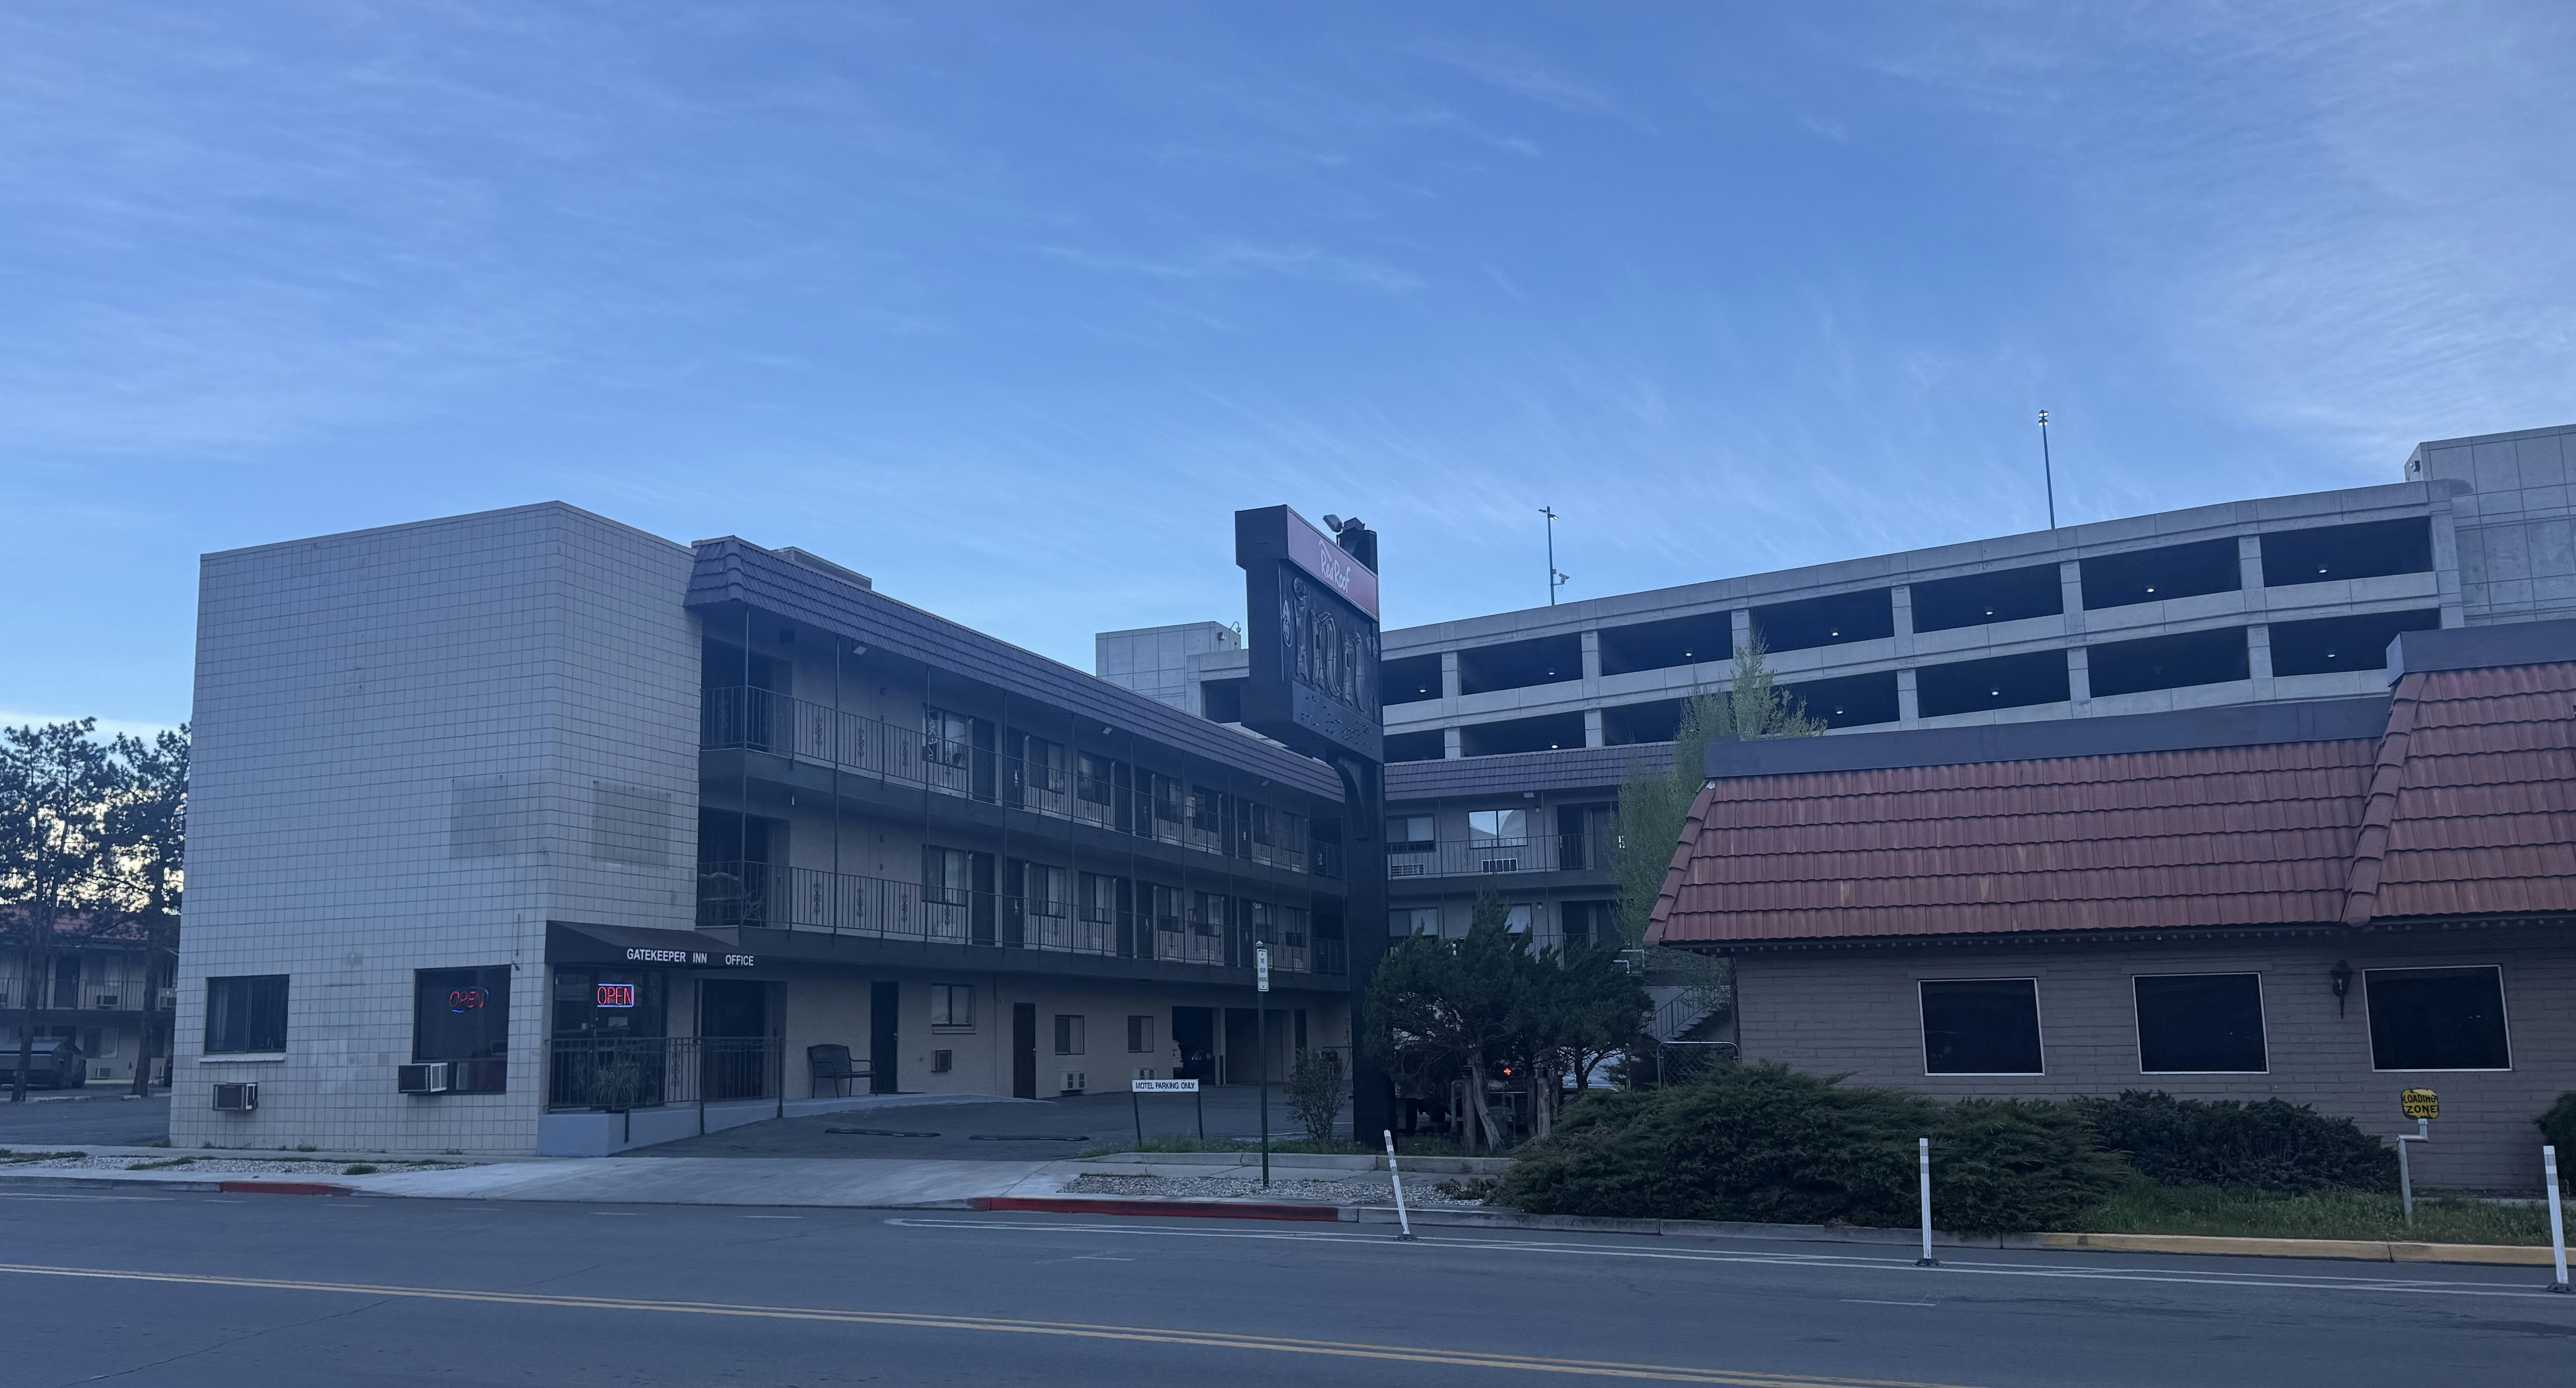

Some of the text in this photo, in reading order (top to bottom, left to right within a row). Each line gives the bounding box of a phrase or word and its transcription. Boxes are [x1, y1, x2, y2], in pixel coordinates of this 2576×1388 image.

[627, 948, 754, 966] GATEKEEPER INN OFFICE
[449, 991, 484, 1008] OPEN
[598, 987, 632, 1005] OPEN
[2403, 1094, 2436, 1103] LOADING
[2405, 1105, 2437, 1113] ZONE
